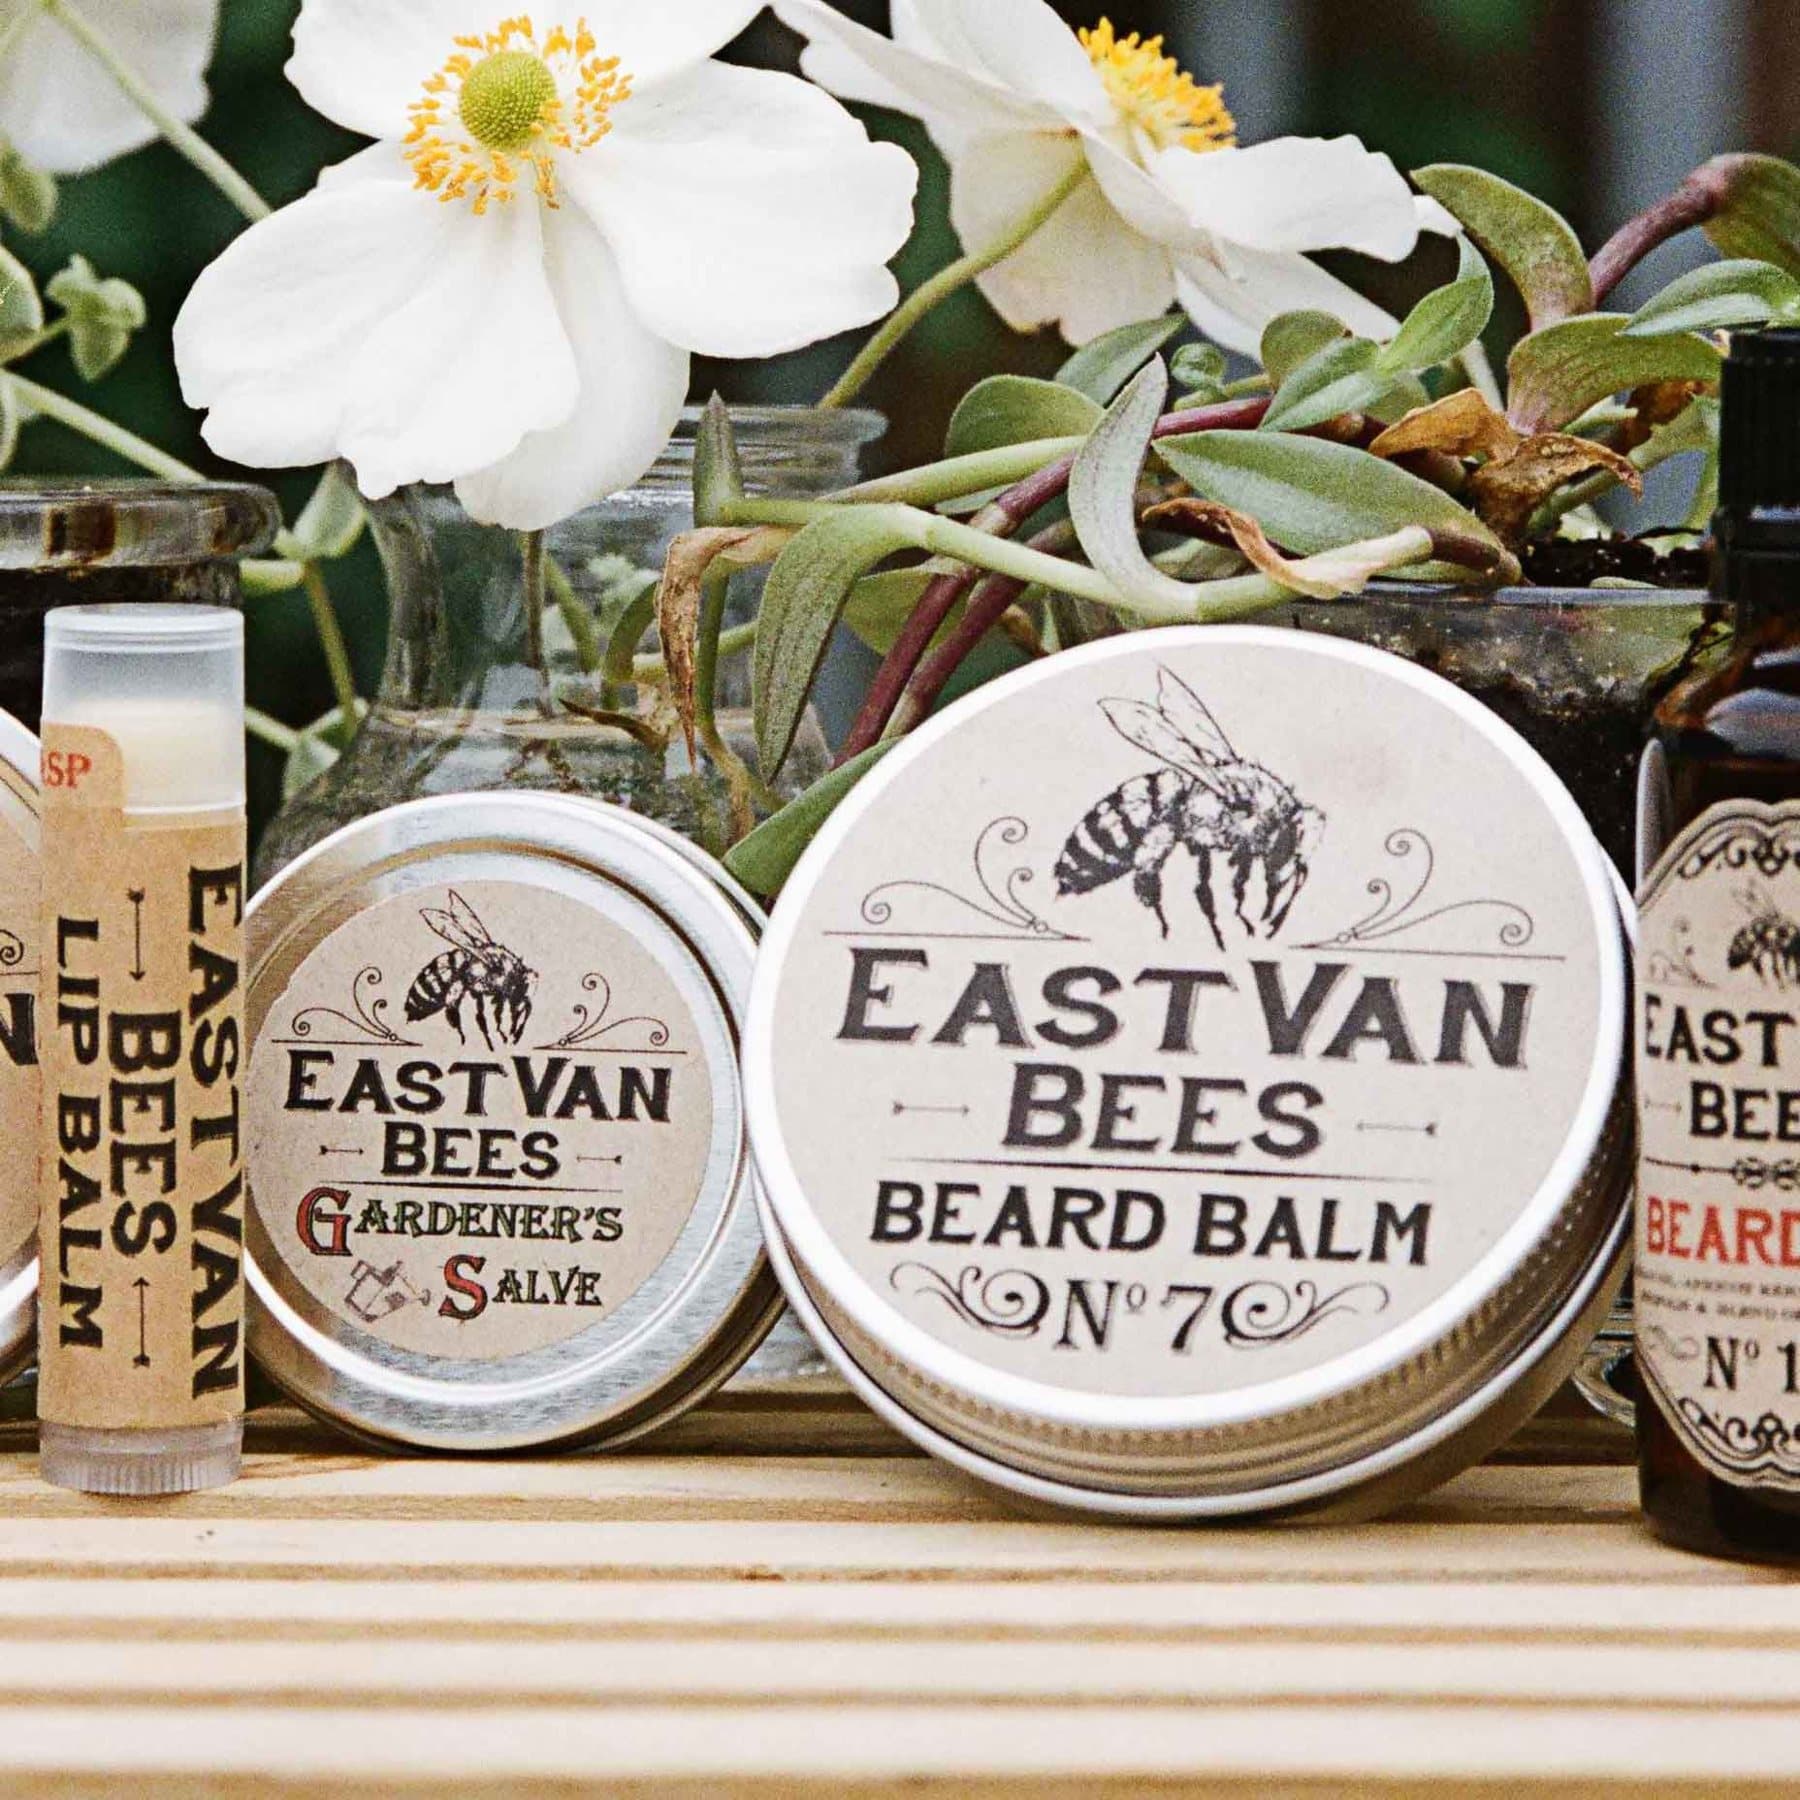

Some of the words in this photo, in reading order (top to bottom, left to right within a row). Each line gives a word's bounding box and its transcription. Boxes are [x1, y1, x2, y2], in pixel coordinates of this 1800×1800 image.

[56, 915, 101, 1066] LIP
[107, 1008, 182, 1258] BEES
[380, 1120, 562, 1181] BEES
[1000, 1061, 1325, 1160] BEES
[57, 1092, 104, 1351] BALM
[298, 1186, 625, 1257] GARDENER'S
[869, 1180, 1168, 1252] BEARD
[1191, 1194, 1434, 1267] BALM
[438, 1253, 604, 1321] SALVE
[1160, 1283, 1214, 1354] 7
